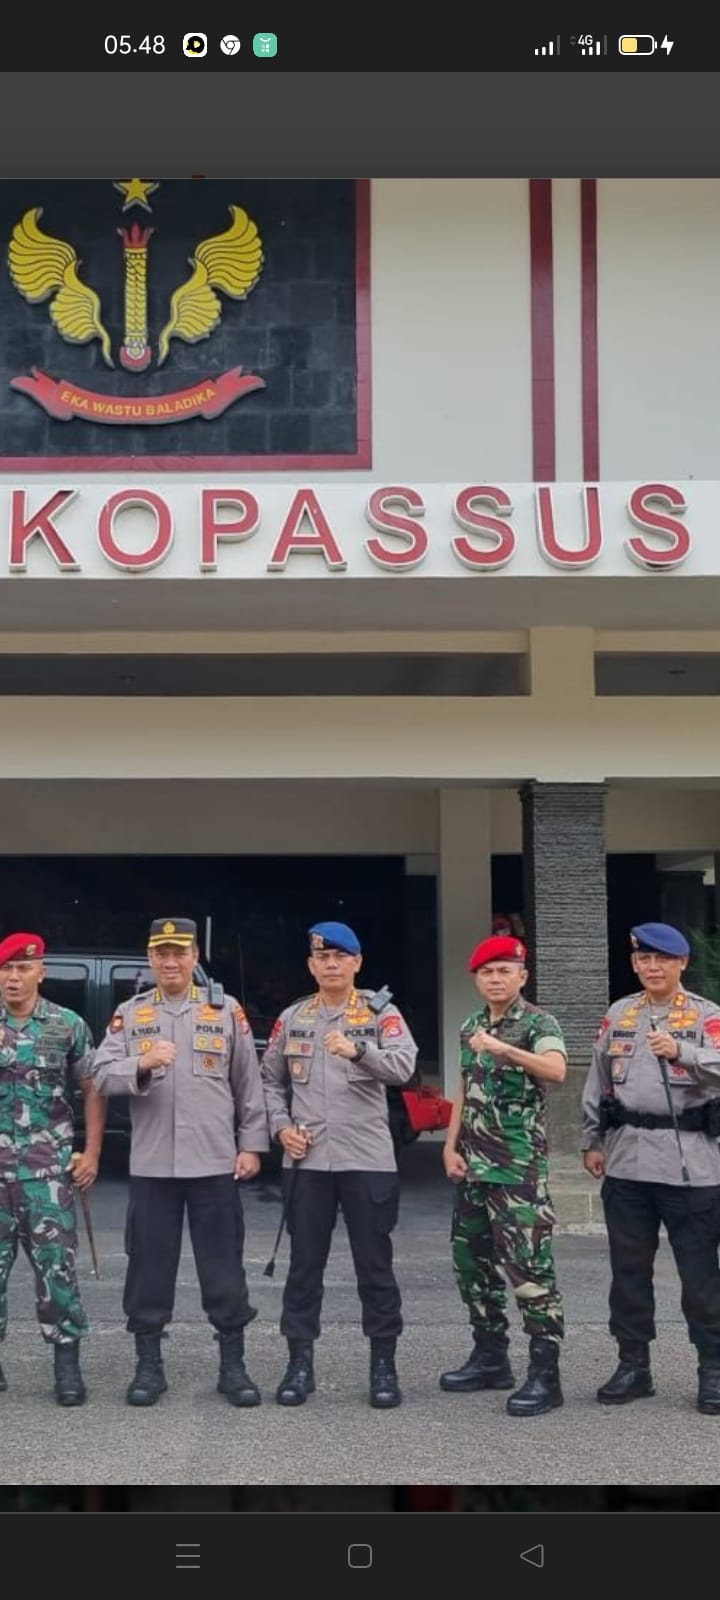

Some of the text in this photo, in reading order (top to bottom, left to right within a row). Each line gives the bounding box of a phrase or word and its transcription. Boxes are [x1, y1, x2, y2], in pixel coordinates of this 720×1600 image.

[61, 388, 216, 416] EKA WASTU BALADIKA
[8, 484, 692, 572] KOPASSUS
[195, 1024, 224, 1034] POLRI
